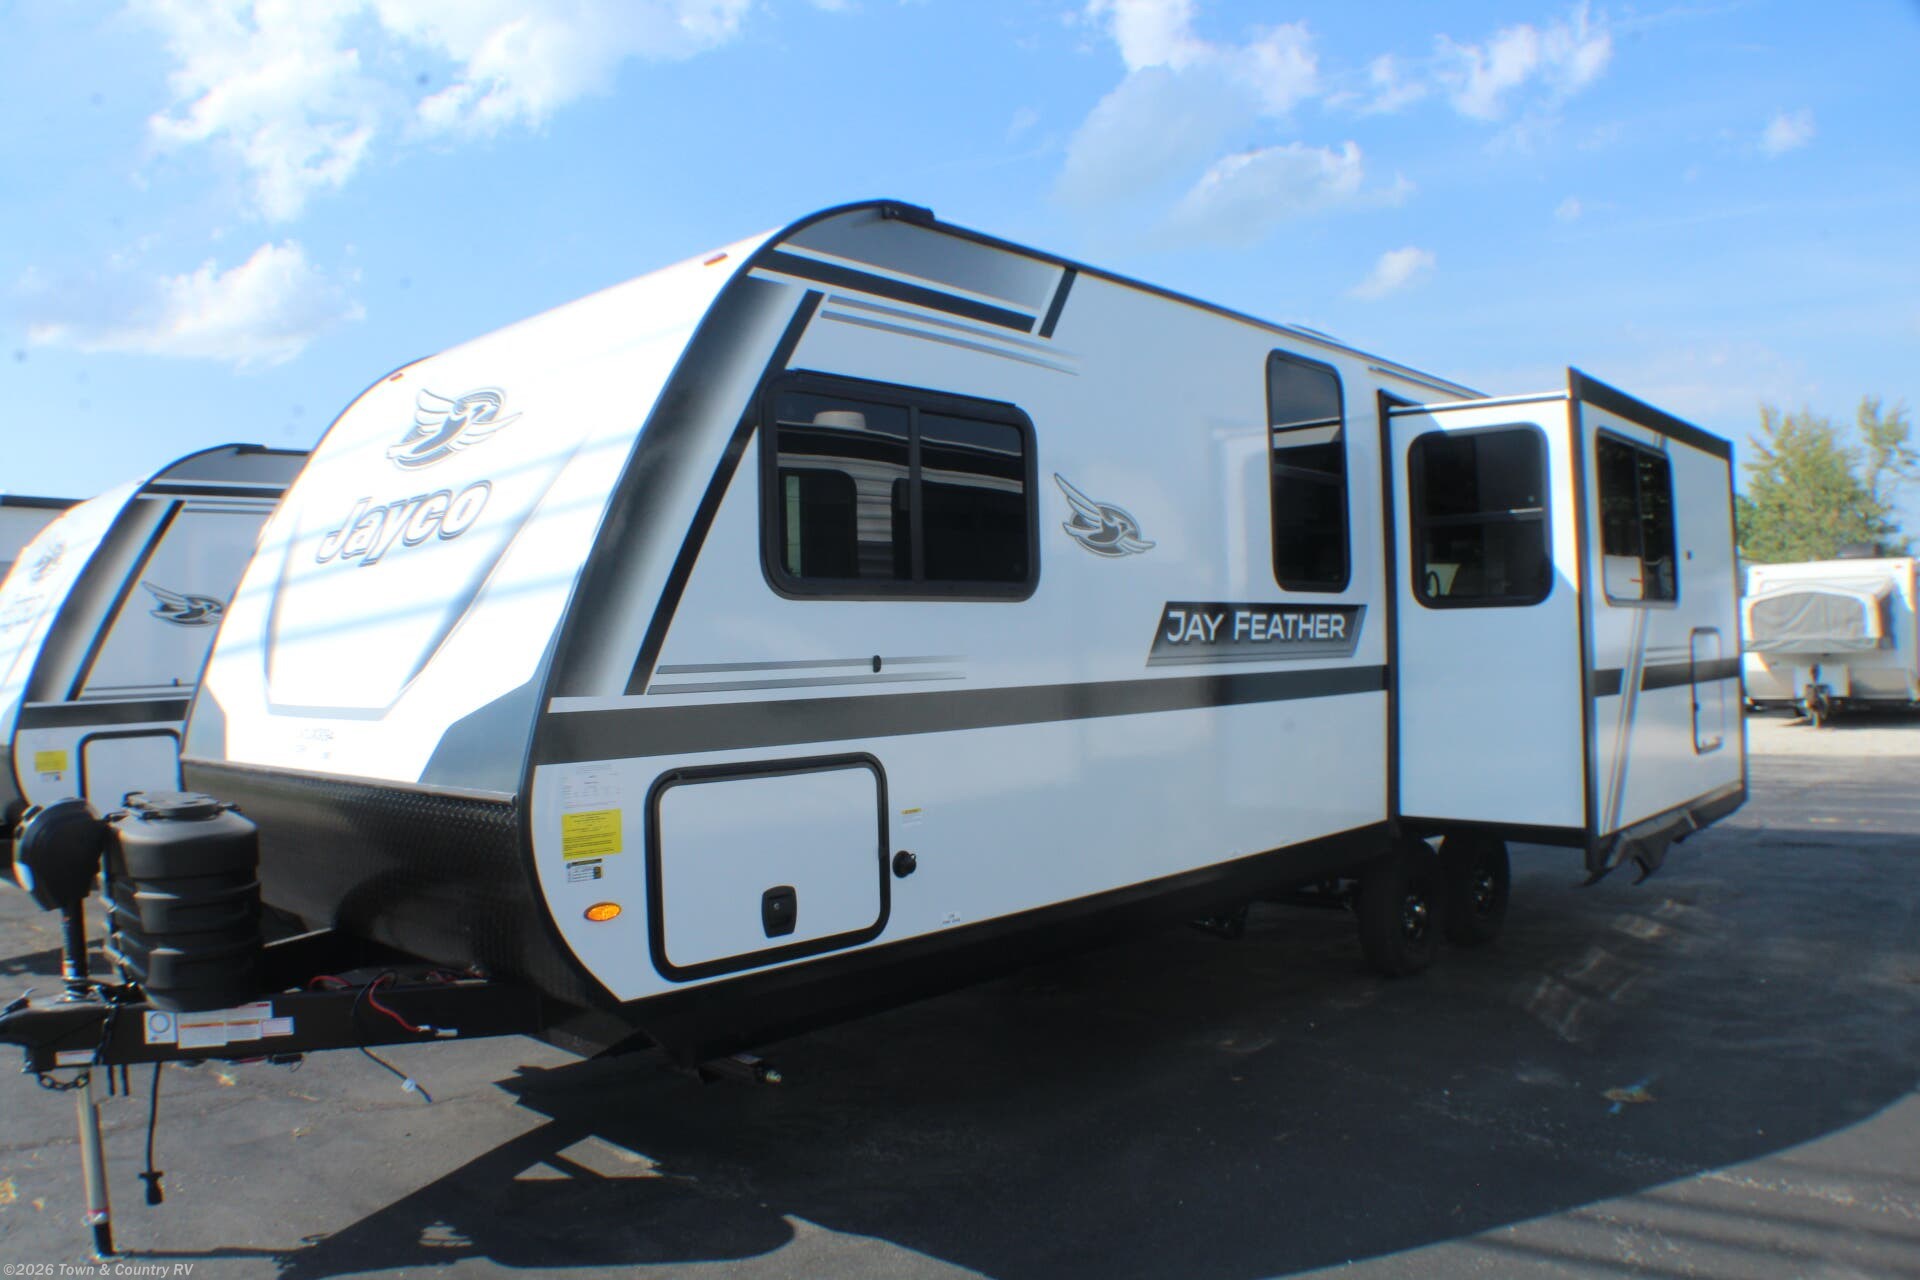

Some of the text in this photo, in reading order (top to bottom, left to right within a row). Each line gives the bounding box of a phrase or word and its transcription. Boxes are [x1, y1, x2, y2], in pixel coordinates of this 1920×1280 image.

[315, 479, 492, 567] Jayco
[1167, 610, 1346, 642] JAY FEATHER
